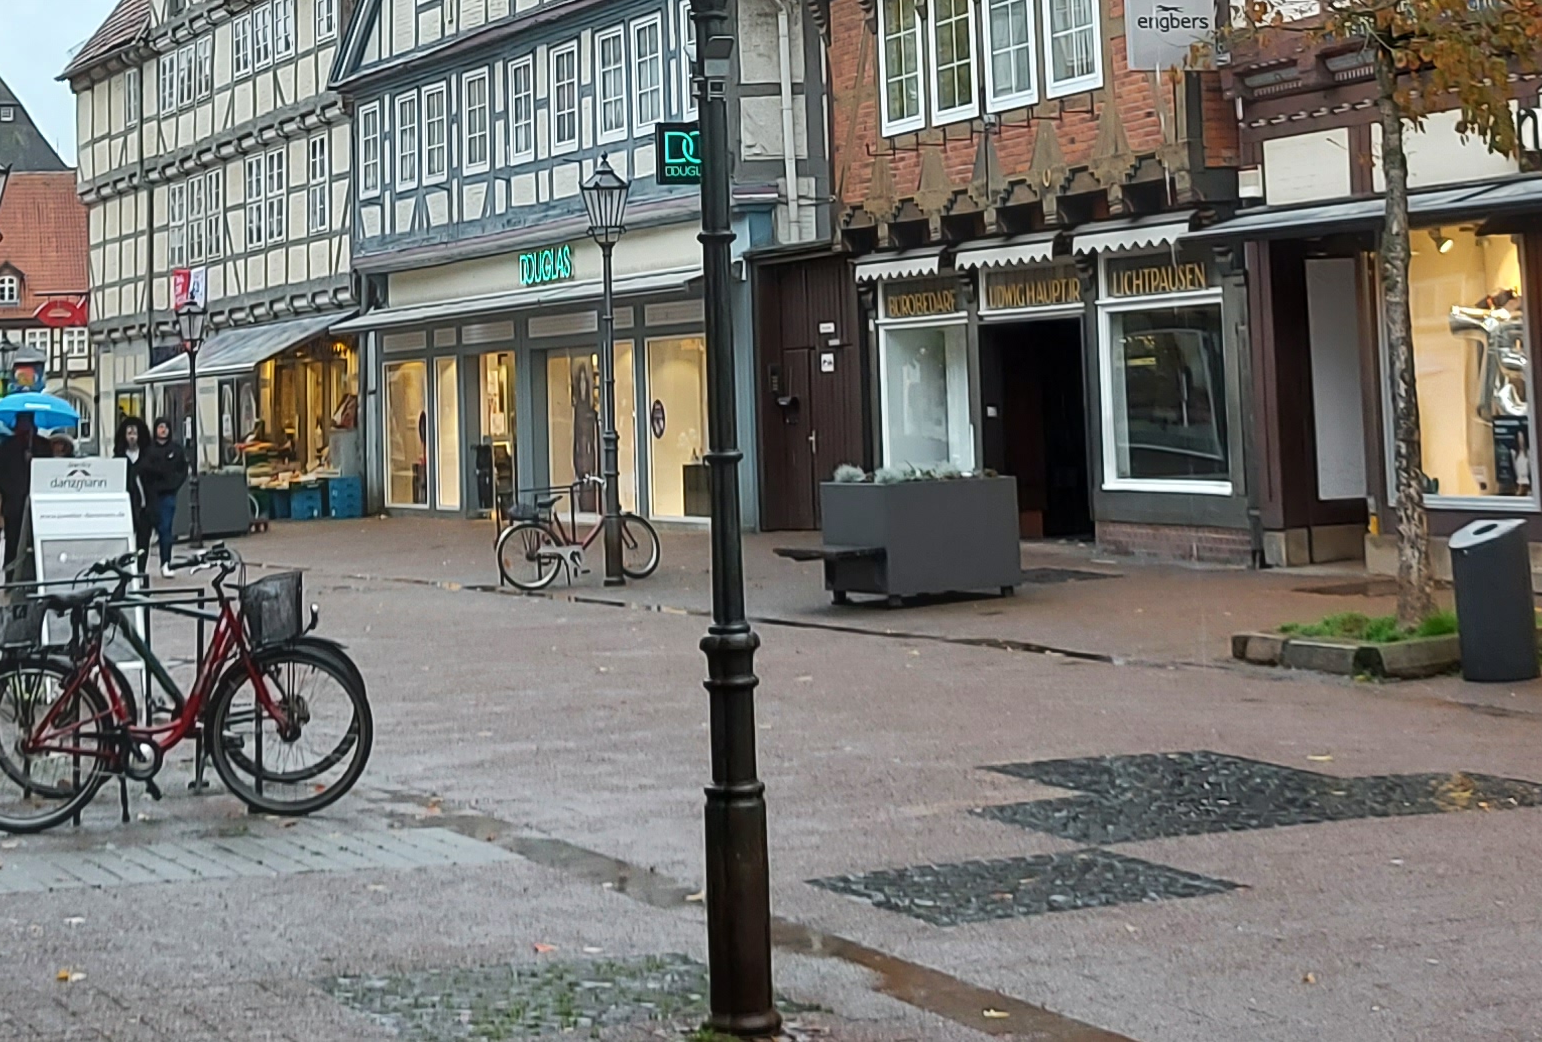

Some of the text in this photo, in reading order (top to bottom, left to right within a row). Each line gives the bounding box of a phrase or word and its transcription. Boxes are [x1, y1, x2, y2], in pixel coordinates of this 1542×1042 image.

[1137, 12, 1209, 33] engbers
[519, 244, 572, 286] DOUGLAS
[1113, 262, 1206, 296] LICHTPAUSEN
[1026, 278, 1067, 305] HAUPT
